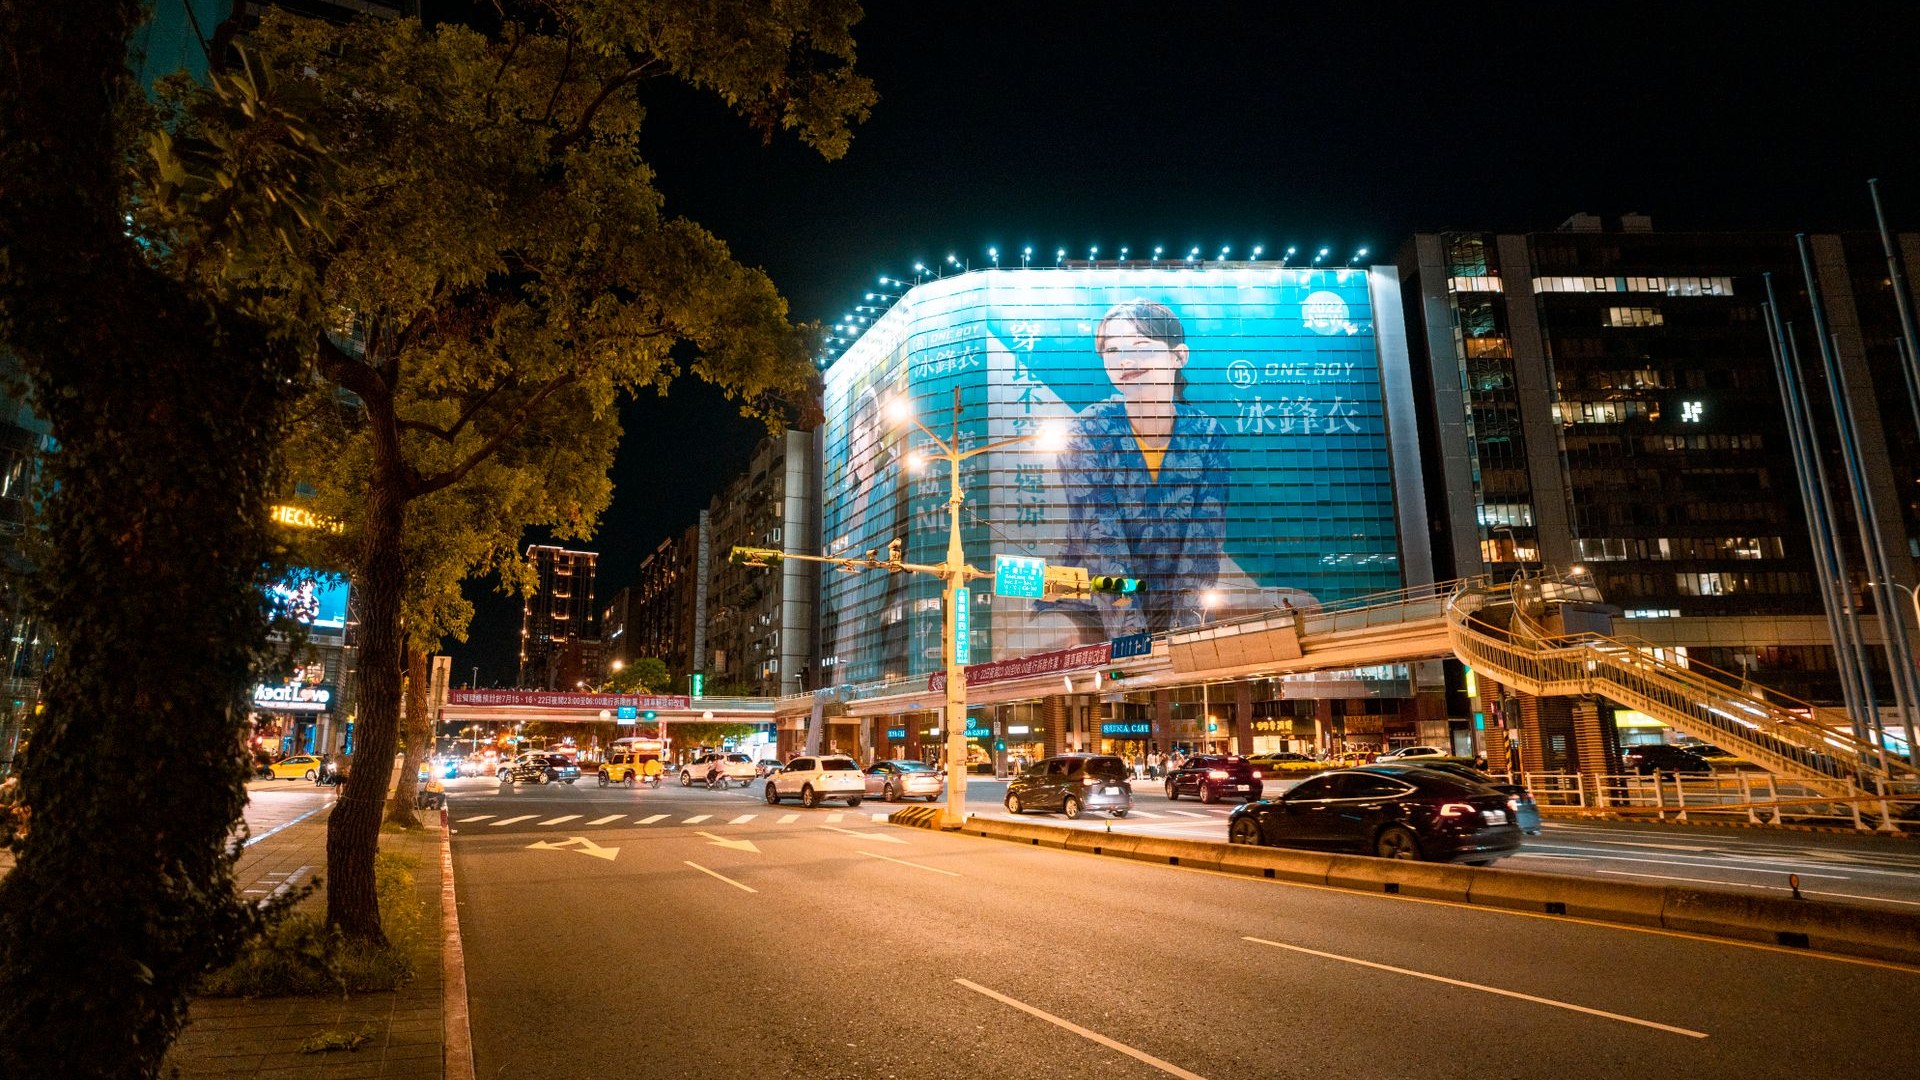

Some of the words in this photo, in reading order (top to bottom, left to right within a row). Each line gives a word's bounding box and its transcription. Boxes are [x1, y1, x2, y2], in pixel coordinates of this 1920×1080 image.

[930, 332, 953, 343] ONE
[956, 325, 980, 338] BOY
[913, 345, 981, 378] 冰鋒衣
[1264, 362, 1309, 376] ONE
[1313, 362, 1355, 376] BOY
[1234, 395, 1361, 434] 冰鋒衣
